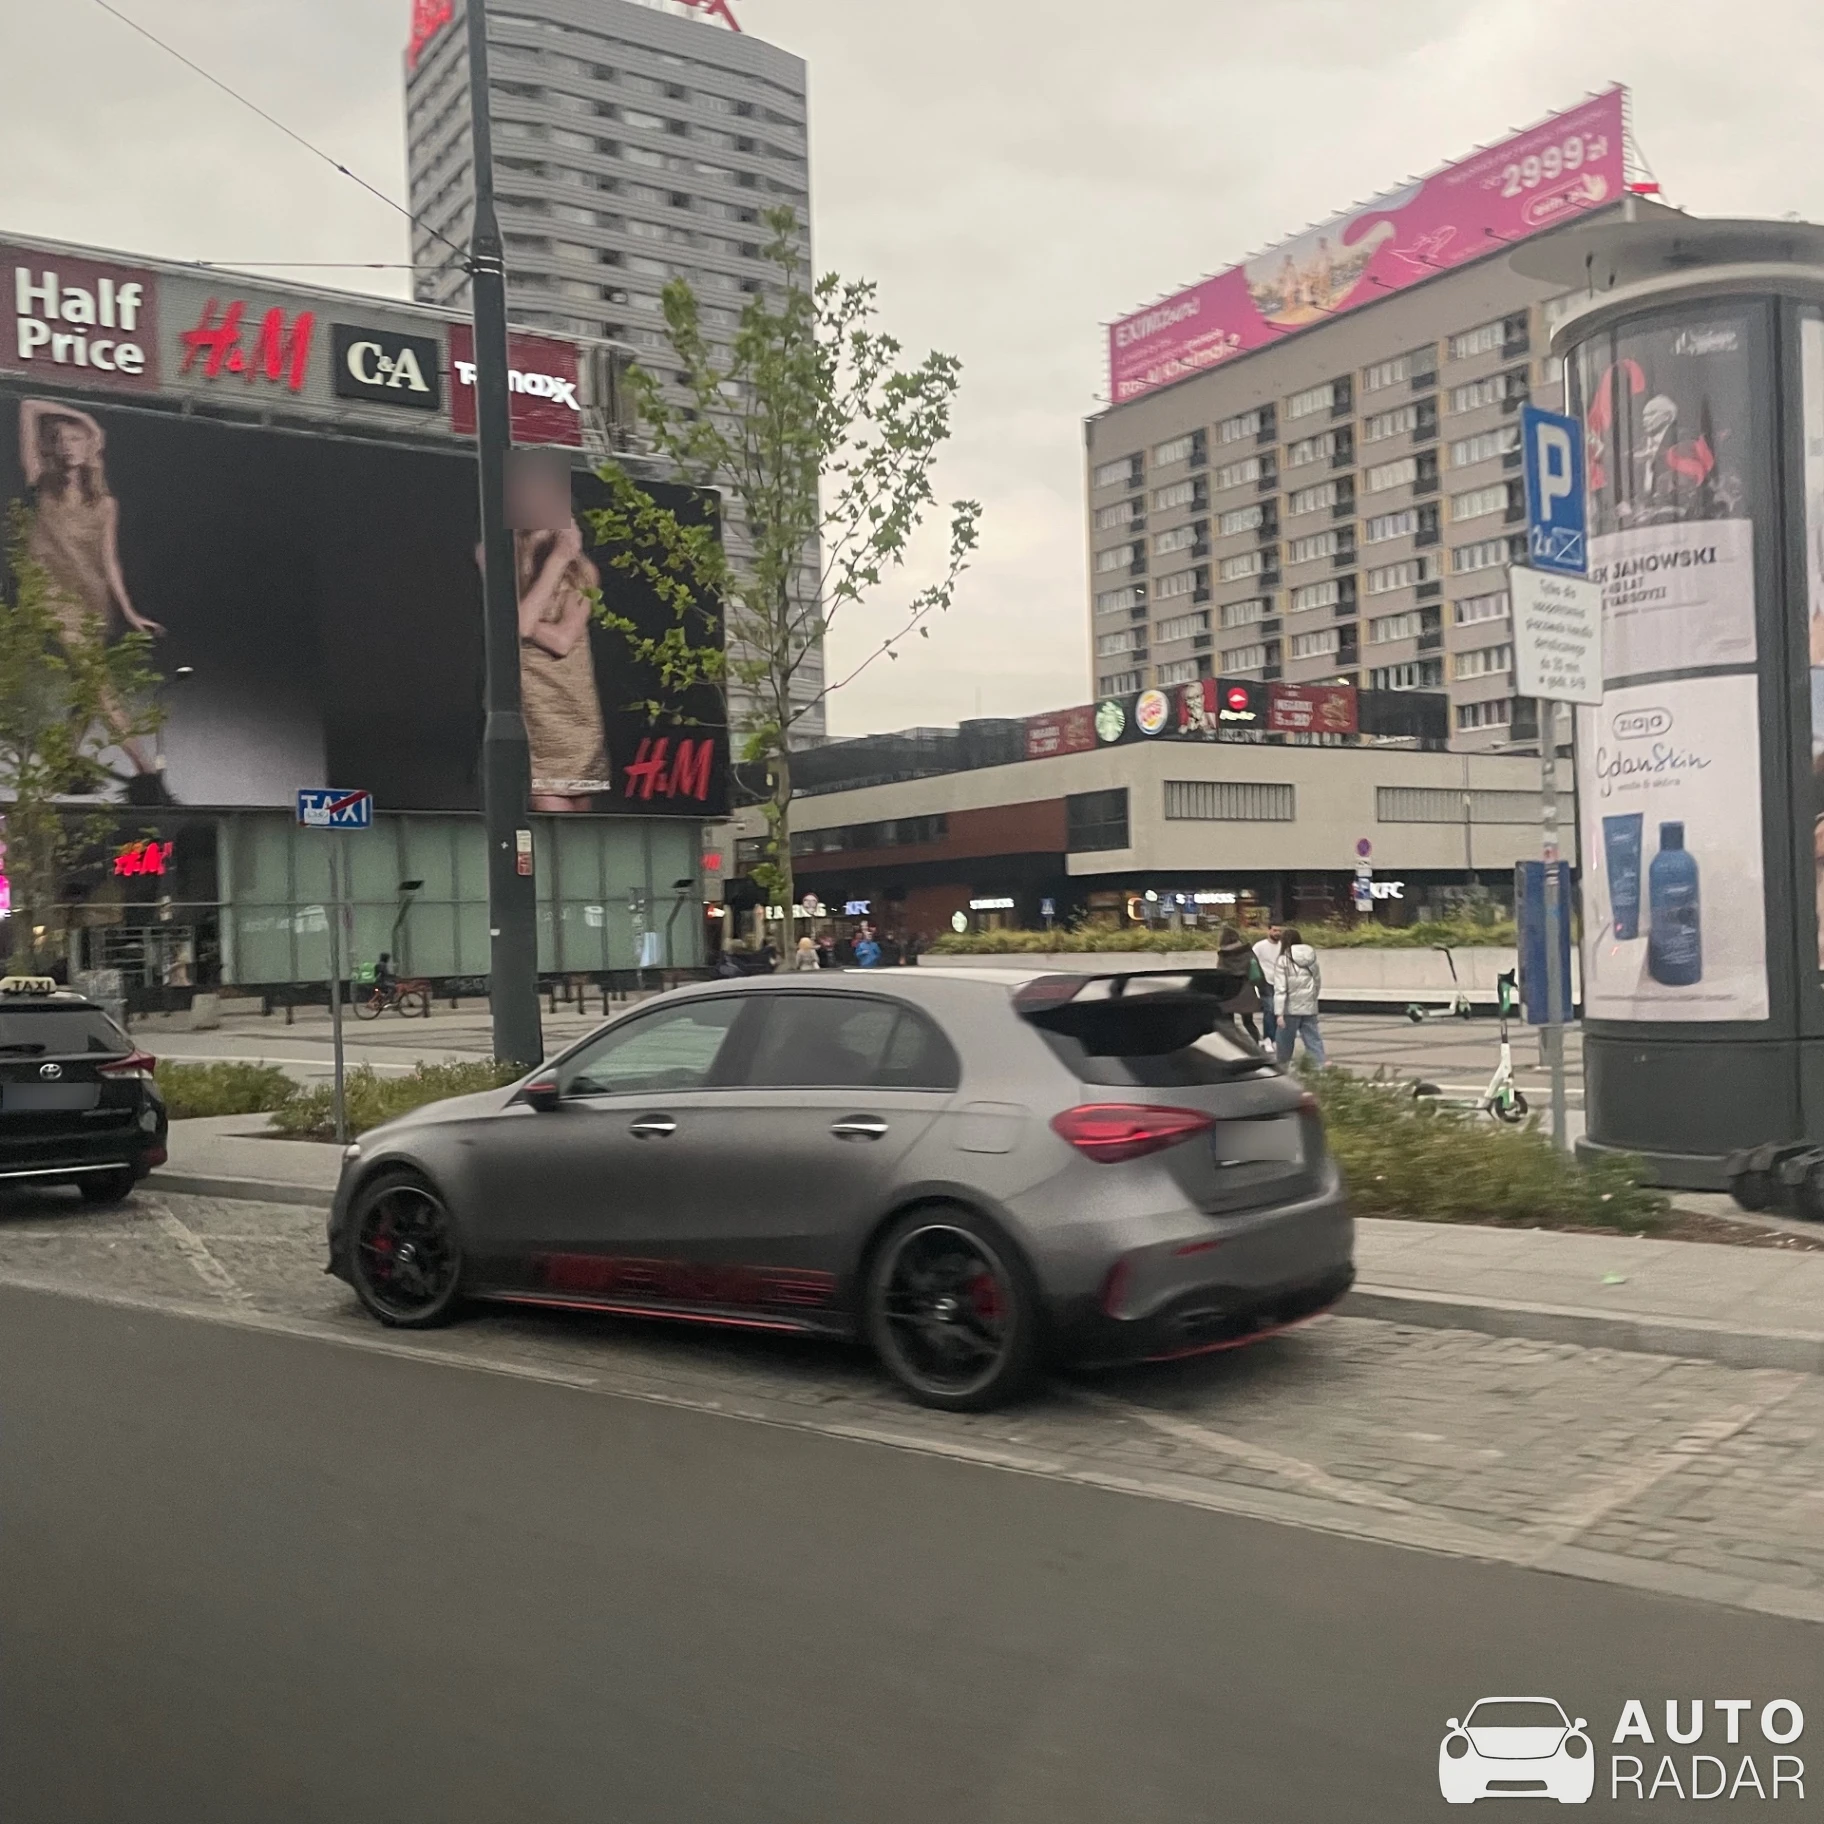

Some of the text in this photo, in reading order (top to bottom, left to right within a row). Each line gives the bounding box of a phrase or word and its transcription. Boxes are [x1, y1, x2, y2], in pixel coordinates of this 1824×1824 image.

[1501, 136, 1584, 198] 2999
[15, 267, 144, 331] Half
[17, 317, 146, 375] Price
[179, 298, 316, 391] H&M
[347, 341, 430, 391] C&A
[1536, 422, 1571, 521] P
[1613, 546, 1718, 580] JANOWSKI
[1620, 715, 1663, 733] ziaja
[623, 736, 715, 801] H&M
[301, 795, 367, 823] TAXI
[1369, 881, 1405, 899] KFC
[13, 980, 51, 991] TAXI
